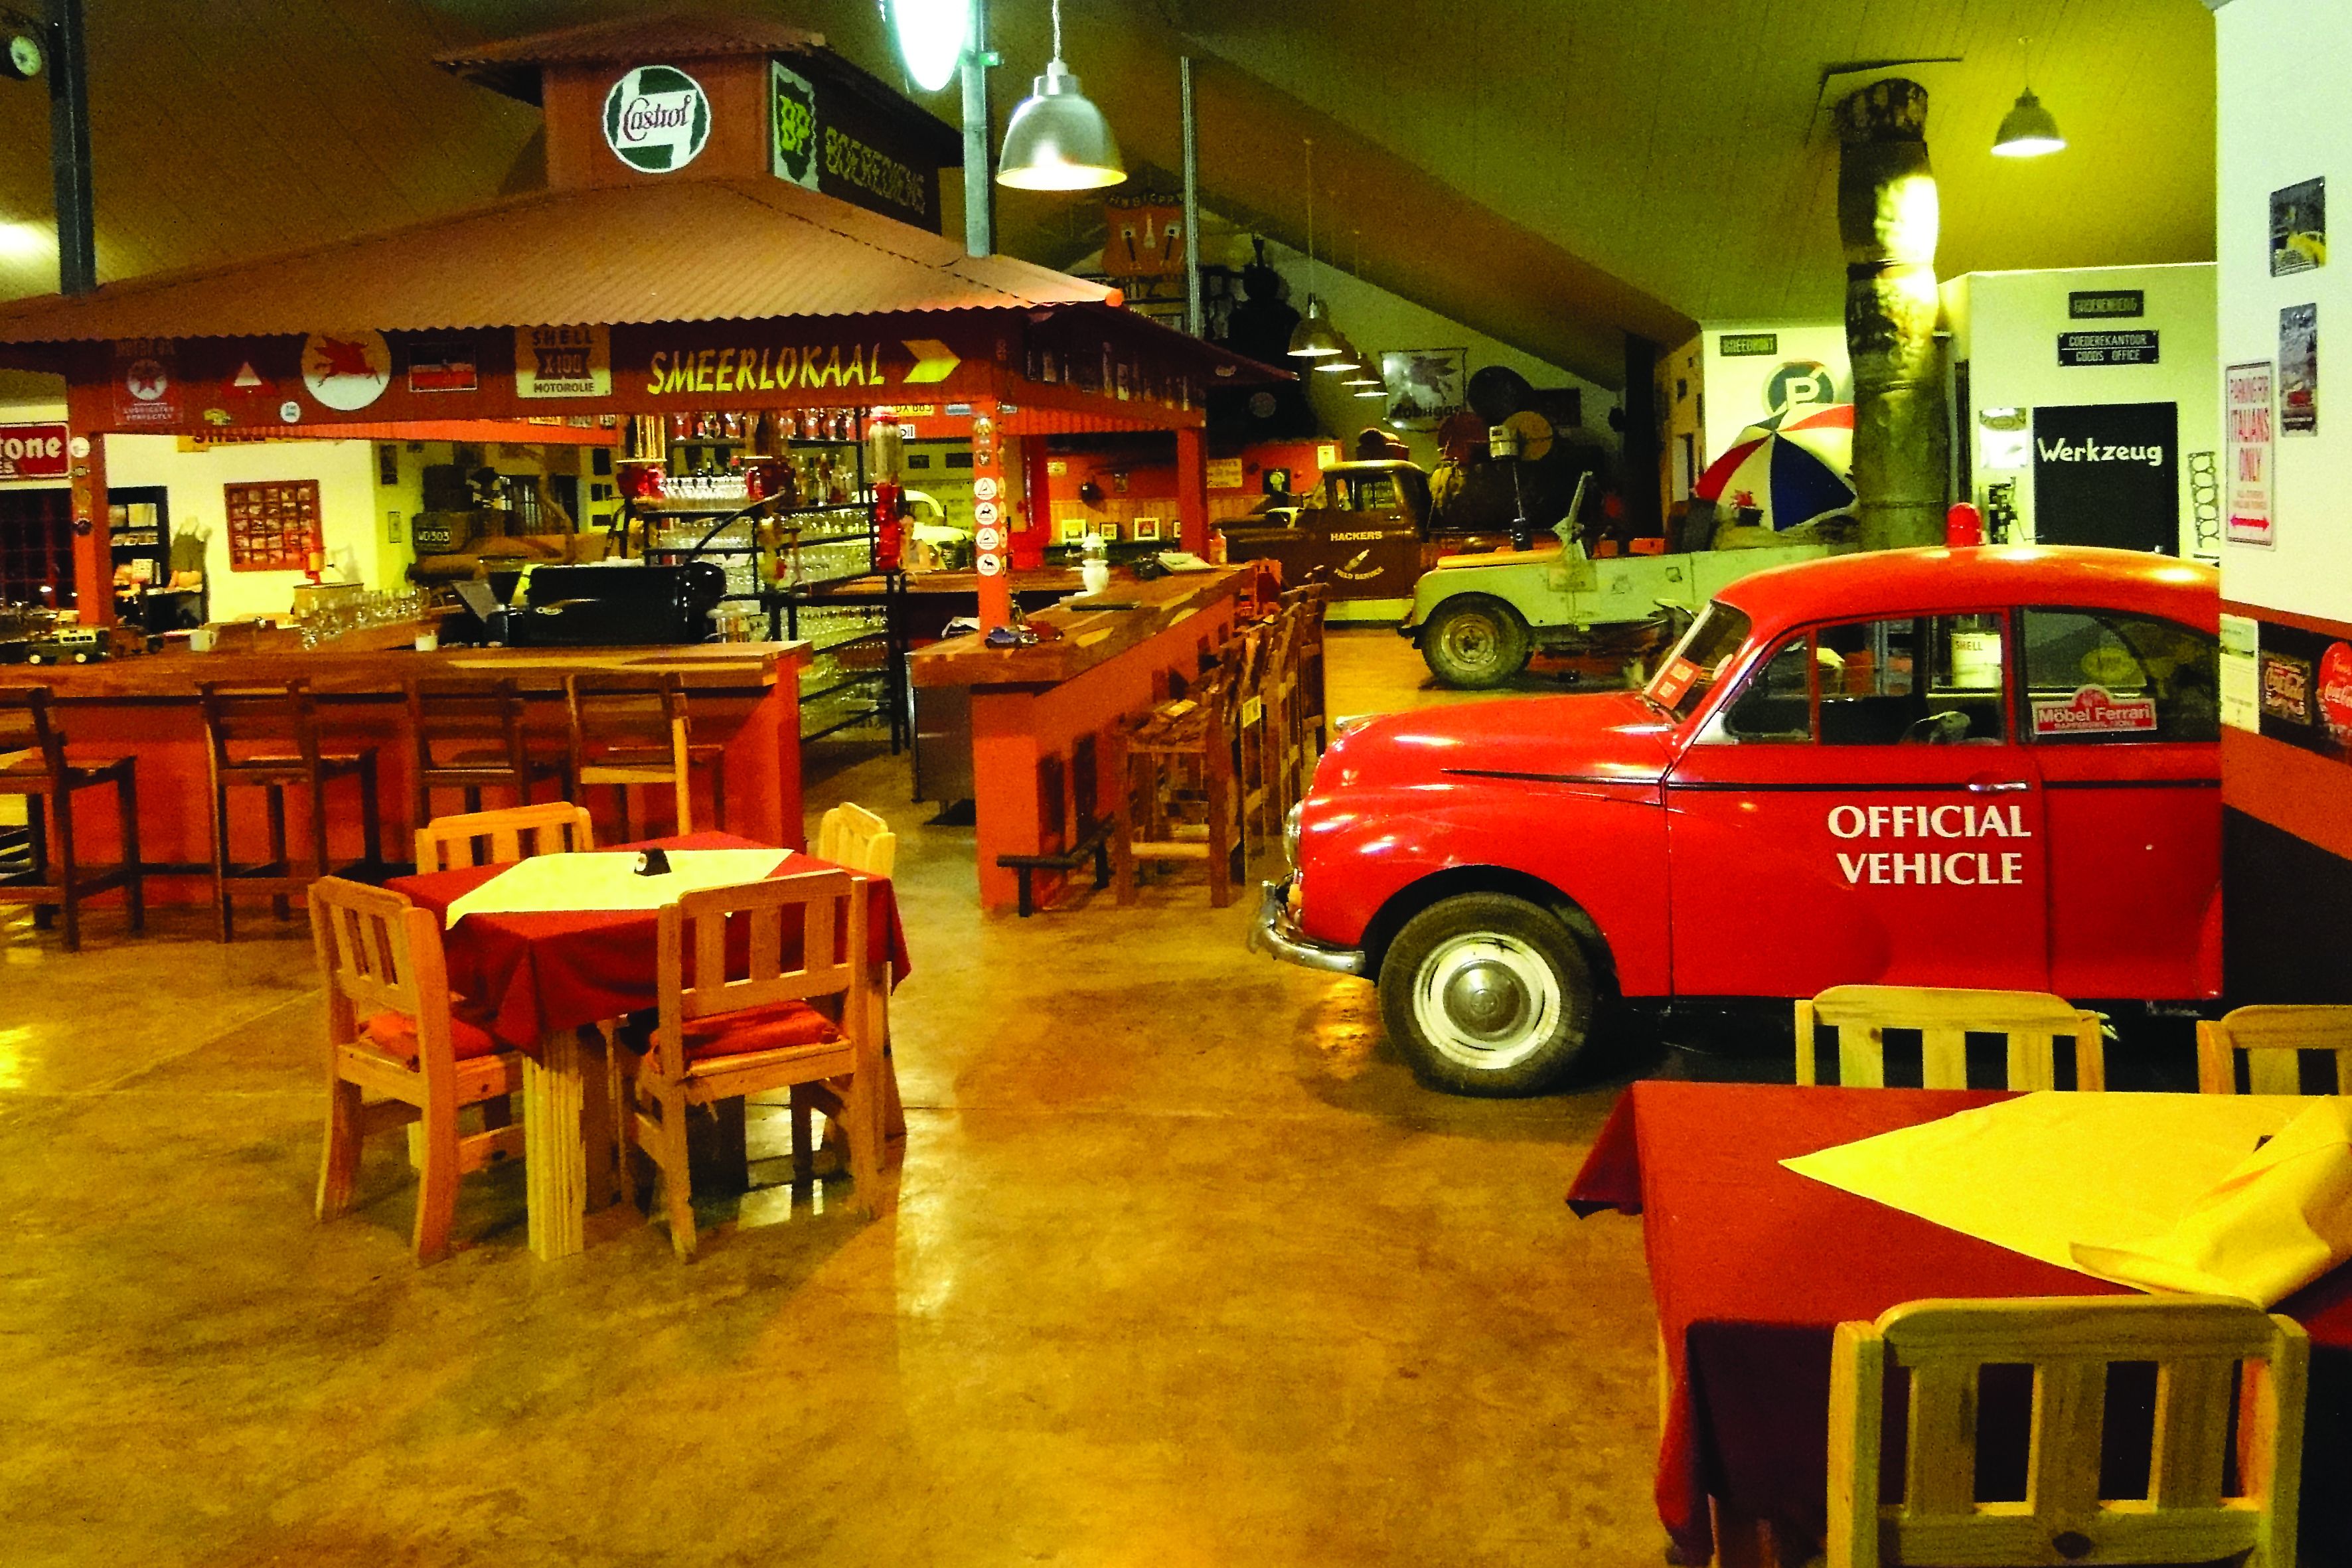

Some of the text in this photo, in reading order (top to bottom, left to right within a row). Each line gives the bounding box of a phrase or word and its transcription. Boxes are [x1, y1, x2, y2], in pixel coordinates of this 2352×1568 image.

[623, 94, 692, 141] Castrol
[779, 94, 811, 156] BP
[533, 329, 594, 346] SHELL
[2112, 349, 2141, 360] OFFICE
[647, 343, 885, 394] SMEERLOKAAL
[534, 382, 595, 393] MOTOROLIE
[0, 436, 62, 460] one
[2037, 437, 2163, 467] Werkzeug
[1330, 531, 1383, 541] HACKERS
[1955, 641, 1983, 651] SHELL
[2039, 704, 2150, 723] Möbel Ferrari
[1828, 805, 2032, 838] OFFICIAL
[1836, 852, 2023, 886] VEHICLE
